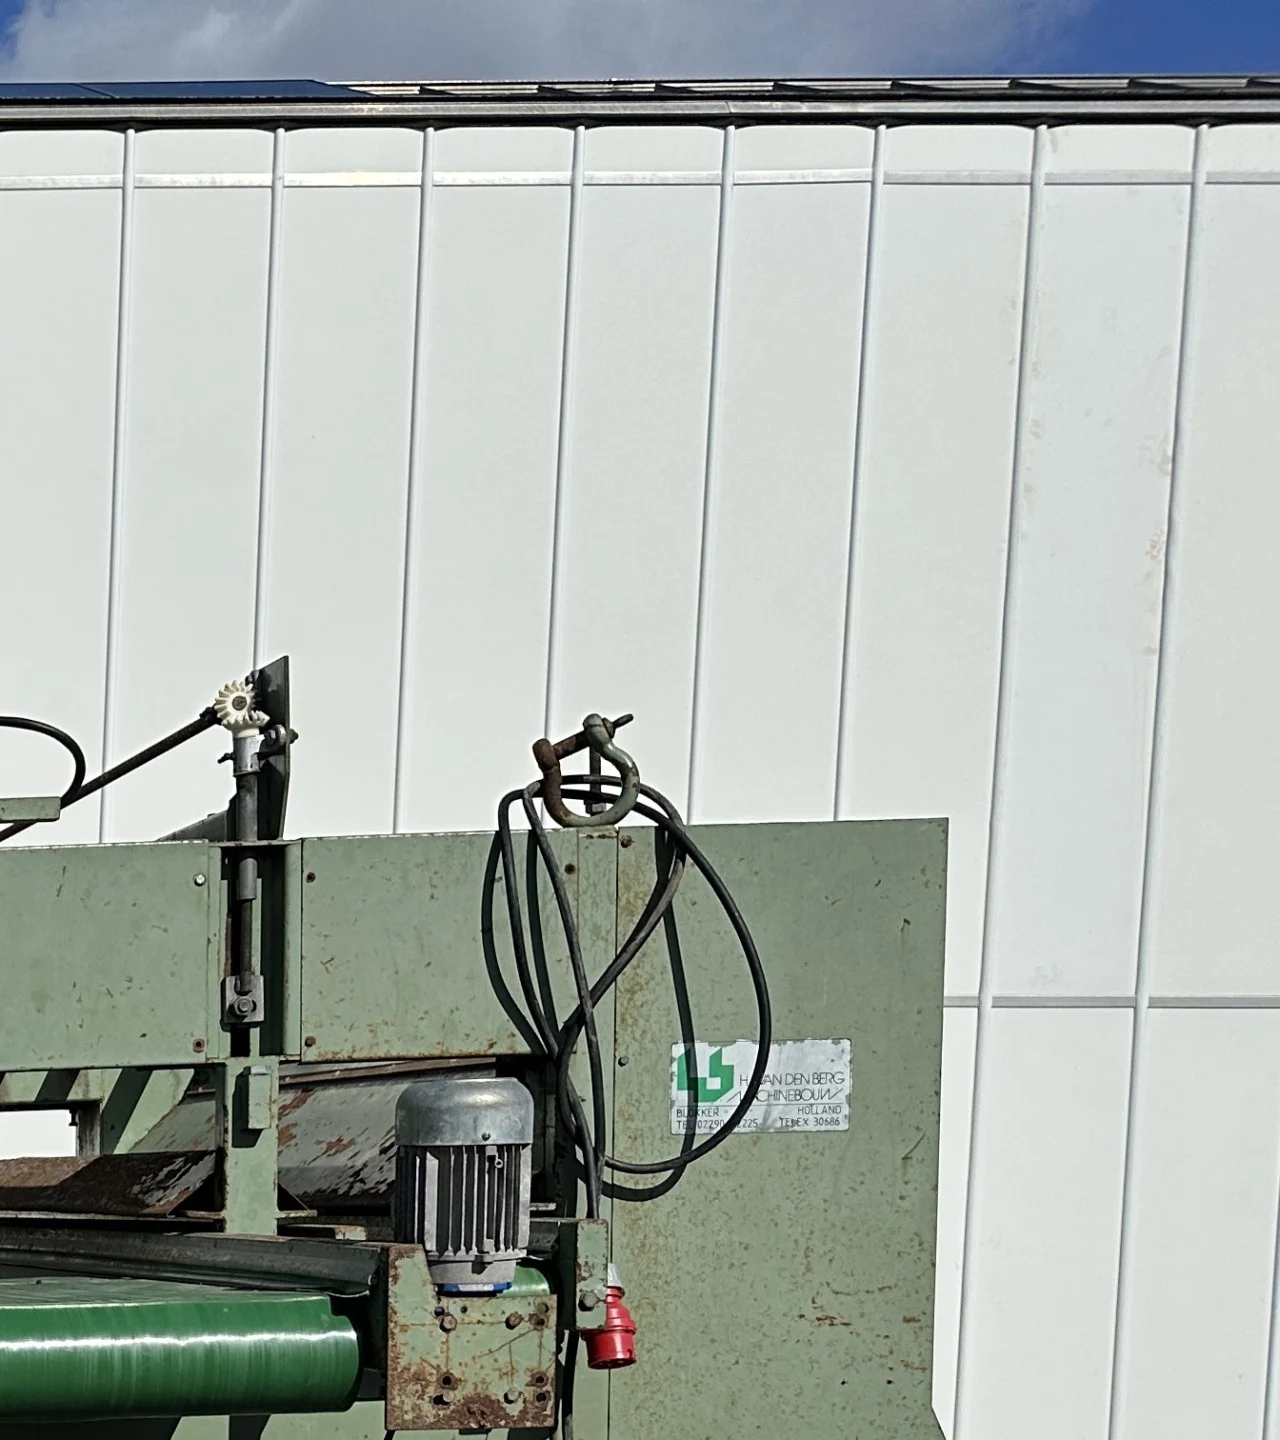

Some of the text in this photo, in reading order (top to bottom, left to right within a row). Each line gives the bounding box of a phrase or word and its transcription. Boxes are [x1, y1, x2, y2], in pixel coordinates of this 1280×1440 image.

[785, 1072, 810, 1085] DEN
[812, 1071, 845, 1084] BERG
[798, 1105, 841, 1115] HOLLAND
[780, 1117, 809, 1127] TELEX
[813, 1117, 840, 1127] 30686
